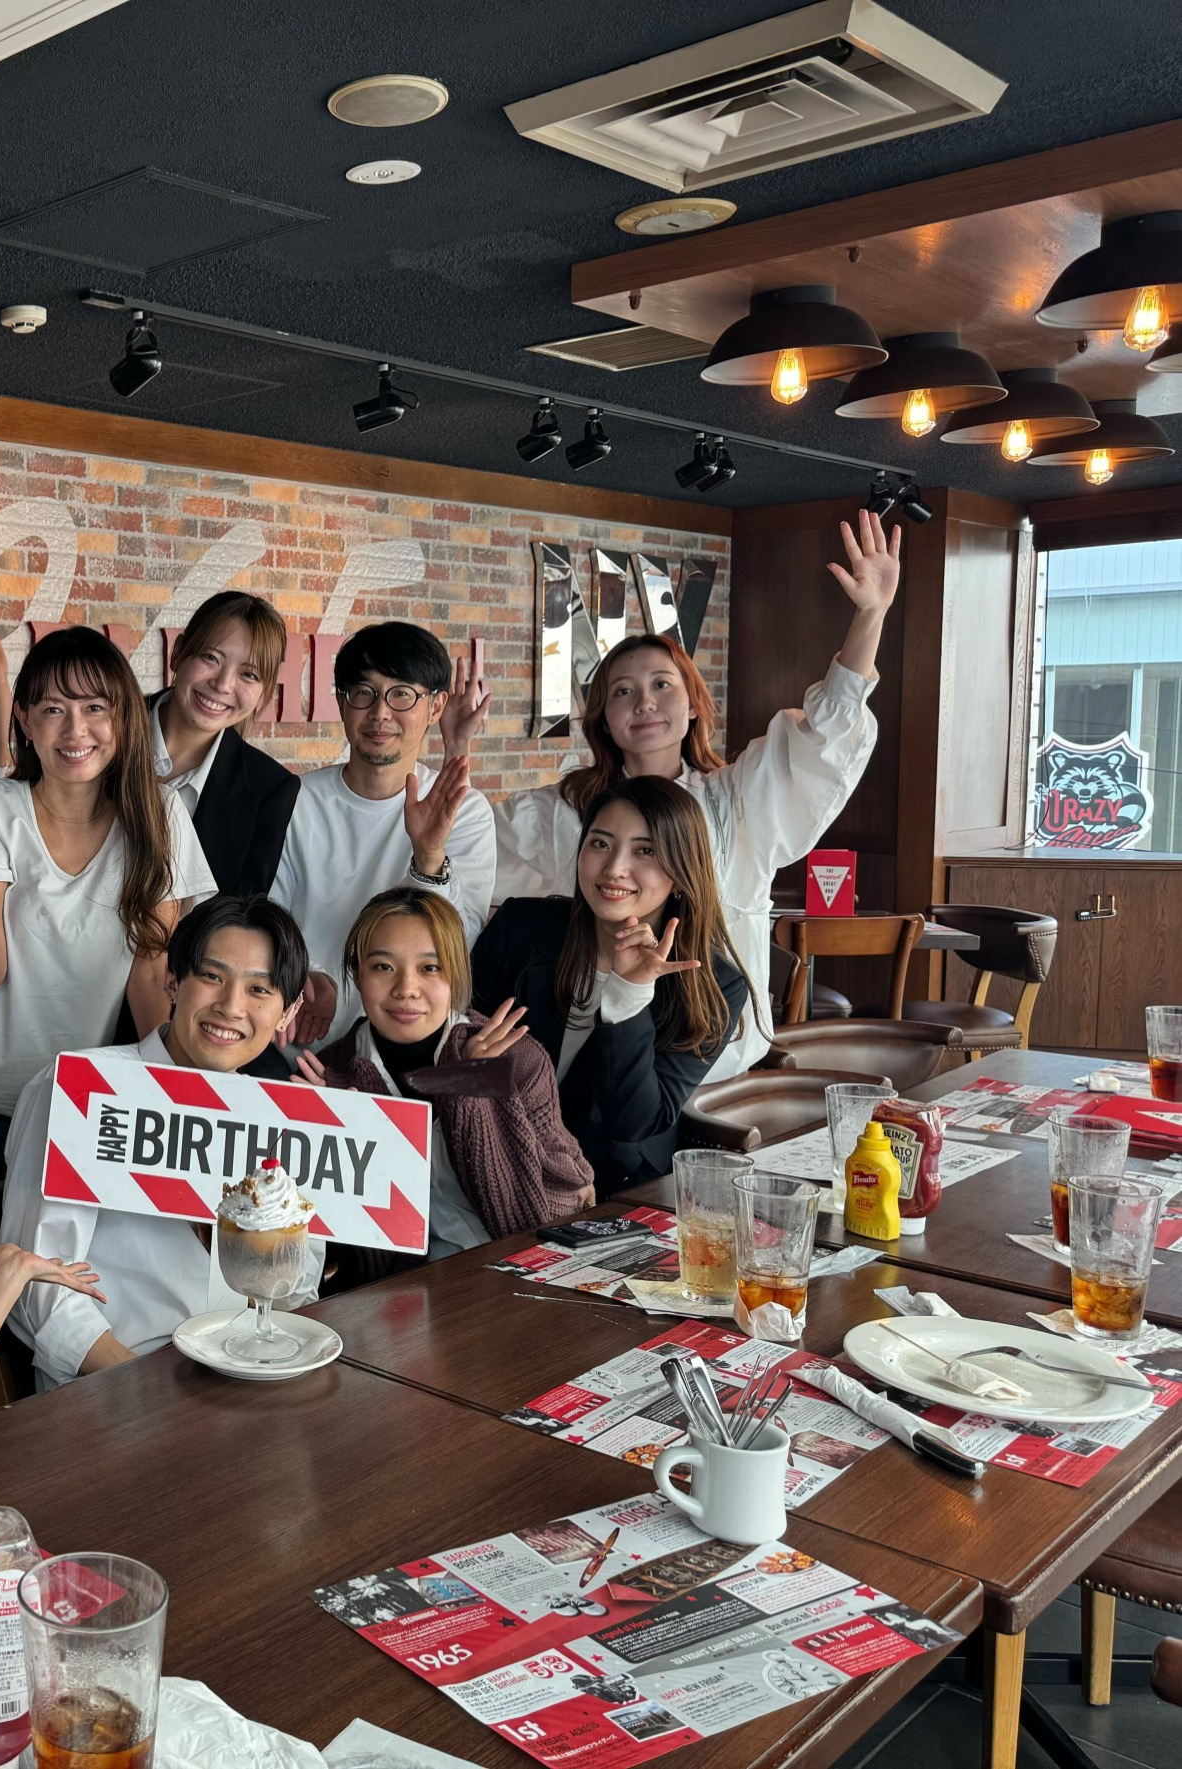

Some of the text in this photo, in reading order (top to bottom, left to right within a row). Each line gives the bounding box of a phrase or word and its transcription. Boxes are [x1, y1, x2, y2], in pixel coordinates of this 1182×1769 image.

[96, 1103, 130, 1164] HAPPY
[131, 1108, 378, 1197] BIRTHDAY
[993, 1453, 1028, 1467] 1st
[595, 1499, 644, 1518] Make Some
[608, 1503, 665, 1526] NOISE!
[443, 1543, 497, 1564] BARTENDER
[452, 1550, 505, 1570] BOOT CAMP
[780, 1615, 802, 1627] office
[804, 1597, 848, 1617] Cocktail
[596, 1626, 624, 1641] Legend
[838, 1622, 875, 1637] Business
[708, 1639, 735, 1652] CAUGHT
[406, 1644, 473, 1671] 1965
[520, 1655, 575, 1679] 58
[448, 1683, 474, 1693] SOUND
[486, 1670, 515, 1683] HAPPY!
[456, 1688, 482, 1699] SOUND
[496, 1673, 531, 1690] BIRTHDAY!
[658, 1672, 728, 1701] HAPPY NEW FRIDAY!
[498, 1720, 547, 1742] 1st
